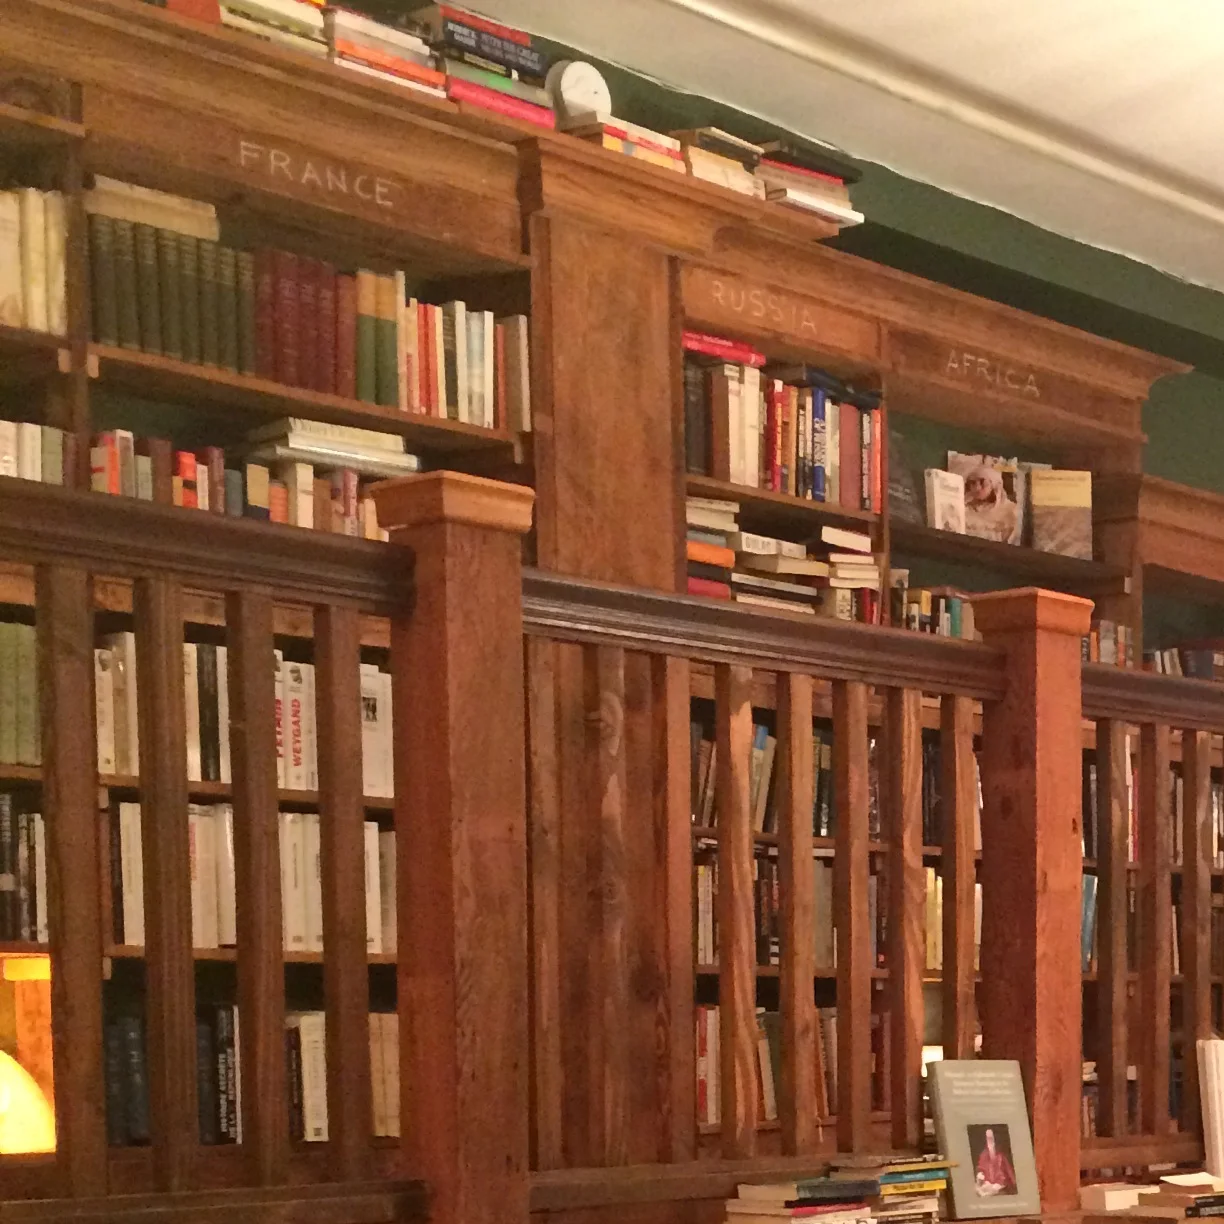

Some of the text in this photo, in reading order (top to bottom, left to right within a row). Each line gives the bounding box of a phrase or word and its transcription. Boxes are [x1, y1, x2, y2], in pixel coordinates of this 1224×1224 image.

[240, 140, 402, 206] FRANCE
[711, 279, 818, 335] RUSSIA
[946, 349, 1040, 397] AFRICA
[290, 698, 303, 767] WEYGAND
